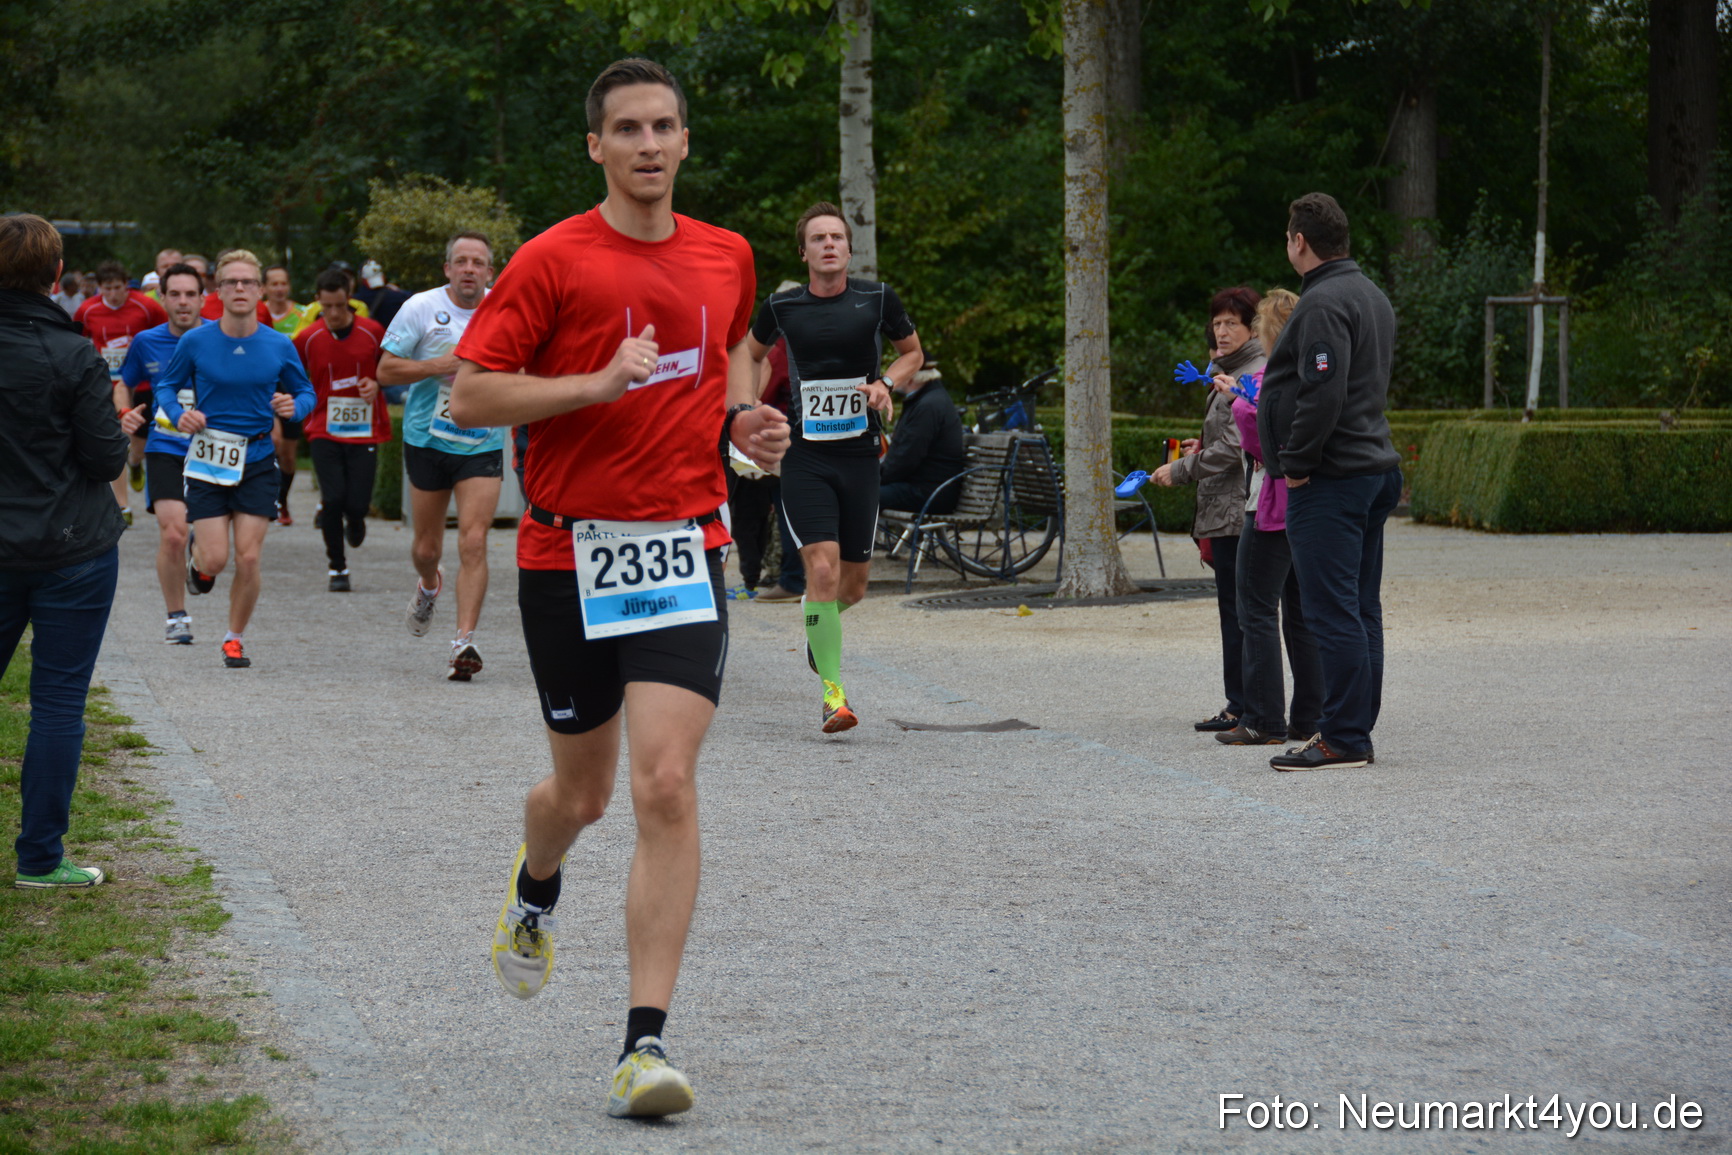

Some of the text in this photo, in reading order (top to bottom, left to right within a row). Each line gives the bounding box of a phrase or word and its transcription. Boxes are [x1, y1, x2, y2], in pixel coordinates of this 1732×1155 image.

[332, 407, 368, 422] 2651
[809, 393, 862, 416] 2476
[815, 420, 856, 432] Christoph
[195, 439, 240, 467] 3119
[590, 536, 695, 590] 2335
[620, 594, 678, 616] Jürgen
